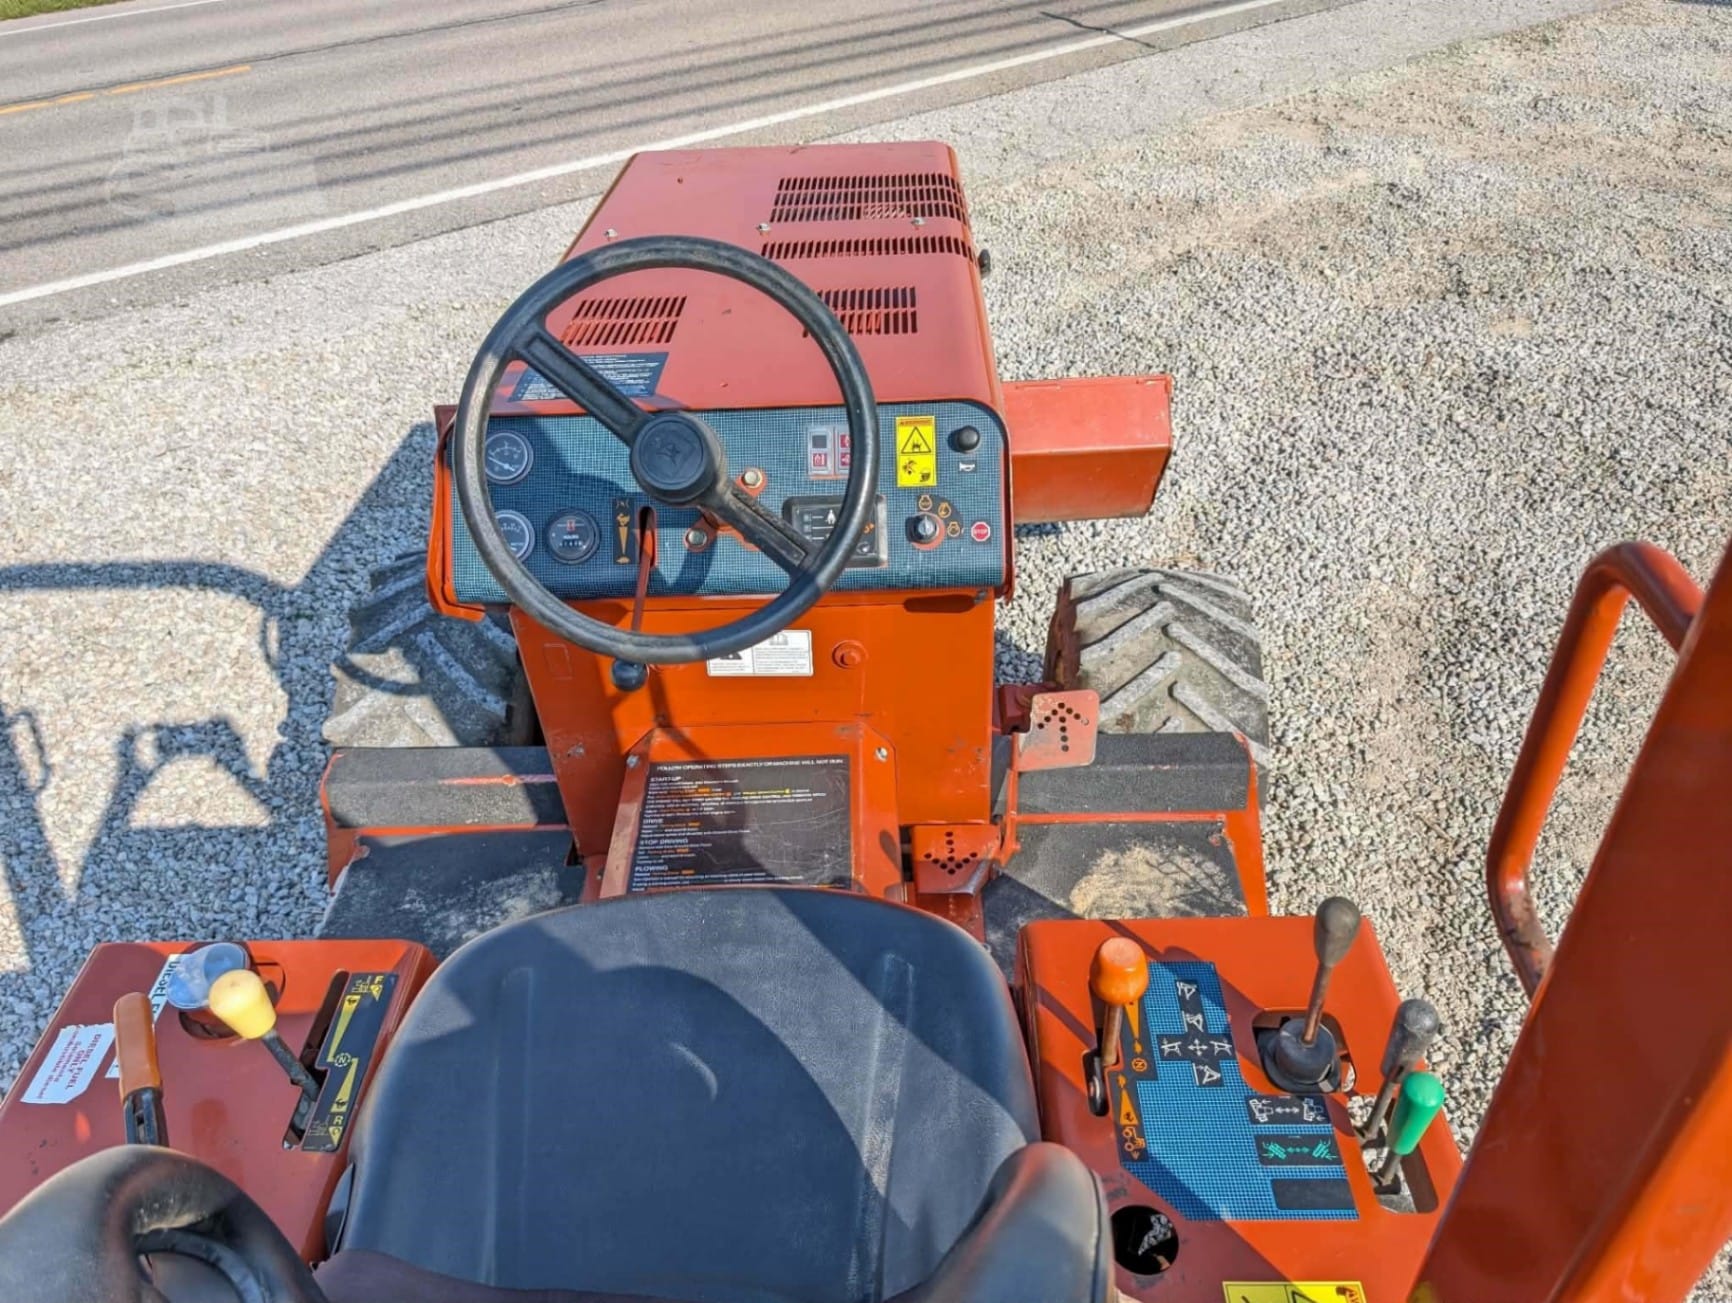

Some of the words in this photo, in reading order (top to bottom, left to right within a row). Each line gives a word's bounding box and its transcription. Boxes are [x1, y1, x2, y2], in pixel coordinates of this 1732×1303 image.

[634, 864, 669, 872] PLOWING
[374, 975, 384, 984] F
[80, 1033, 102, 1065] DIESEL
[67, 1050, 85, 1073] ONLY
[65, 1066, 83, 1090] FUEL
[333, 1115, 343, 1125] R
